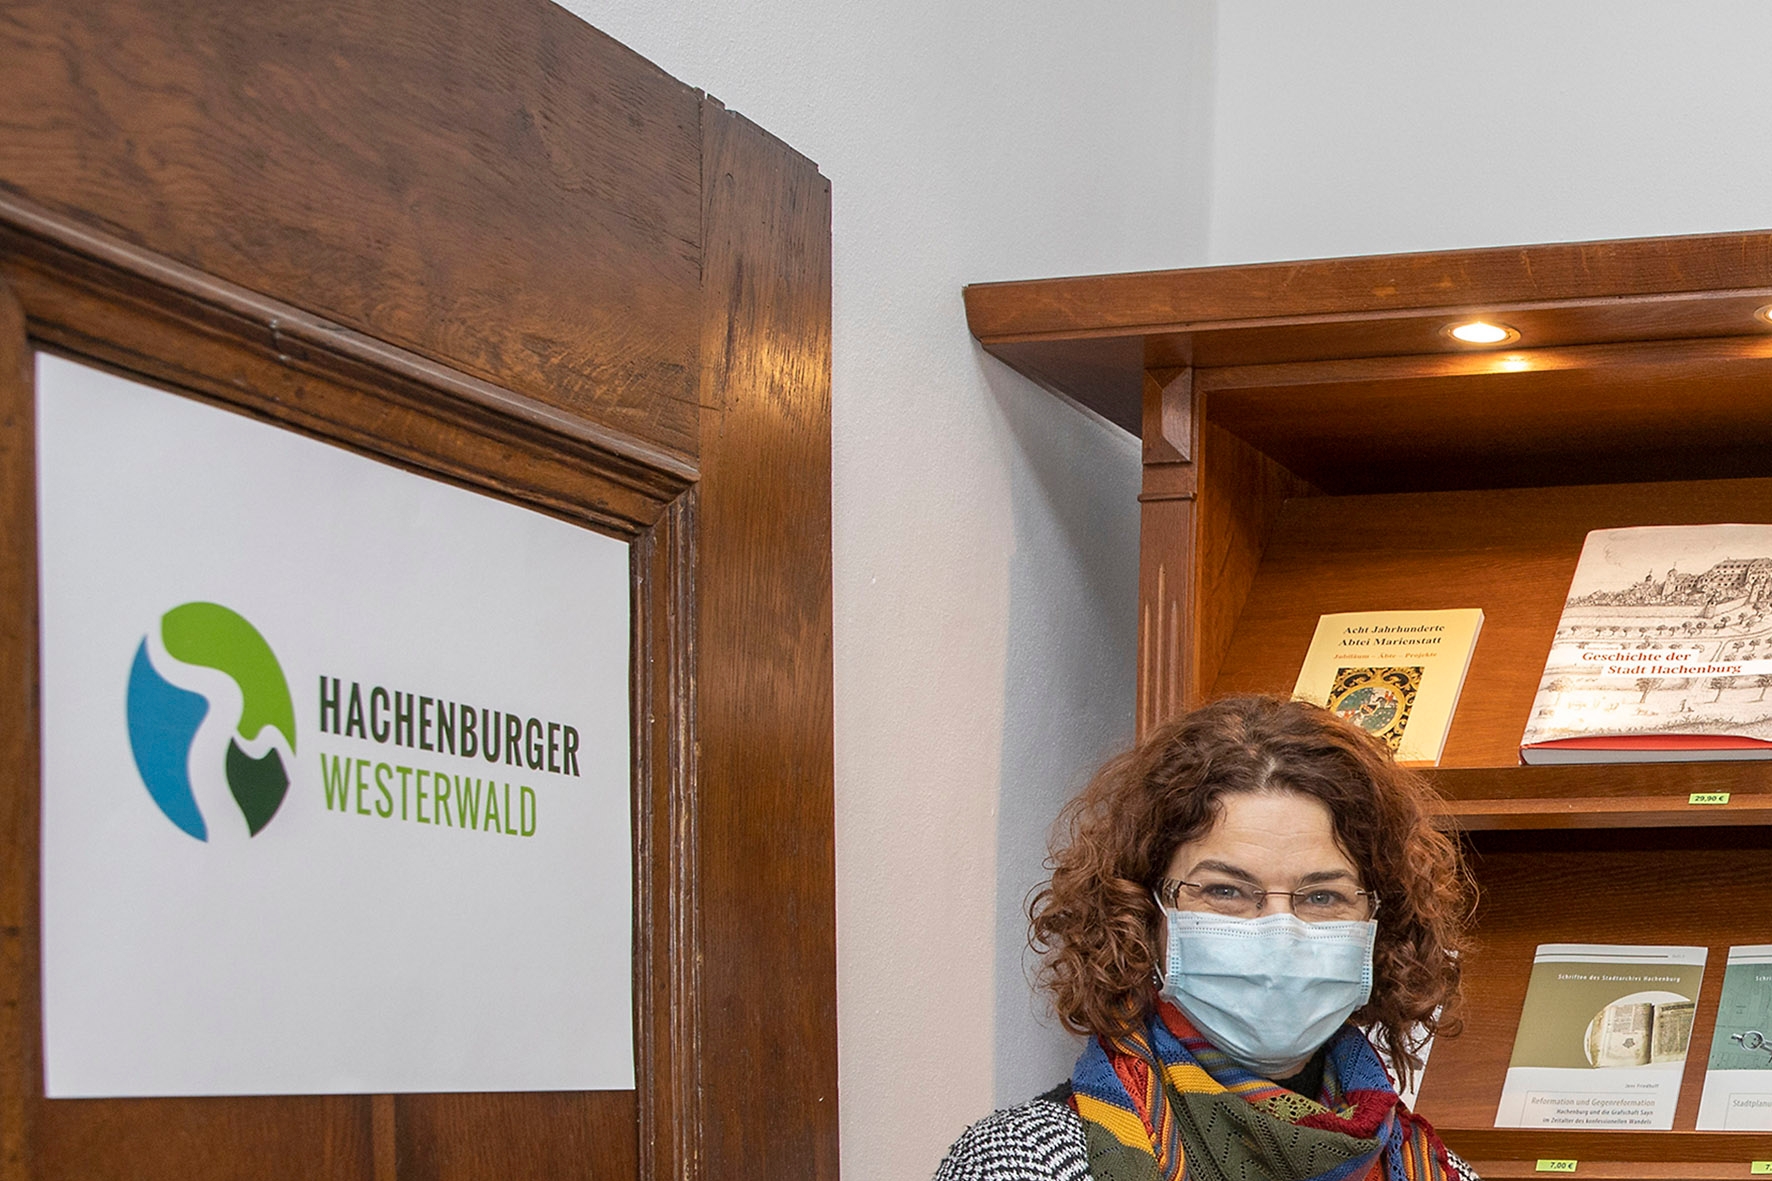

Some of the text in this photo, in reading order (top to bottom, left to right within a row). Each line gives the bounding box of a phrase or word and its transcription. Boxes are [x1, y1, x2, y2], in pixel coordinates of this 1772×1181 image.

[1343, 624, 1445, 634] Acht Jahrhunderte
[1339, 637, 1442, 646] Abtei Marienstatt
[1582, 652, 1691, 662] Geschichte der
[1607, 664, 1743, 675] Stadt Hachenburg
[319, 674, 581, 778] HACHENBURGER
[319, 752, 537, 838] WESTERWALD
[1558, 973, 1588, 981] Schriften
[1602, 974, 1642, 982] Stadtarchivs
[1643, 975, 1681, 983] Hachenburg
[1530, 1096, 1656, 1108] Reformation und Gegenreformation
[1550, 1162, 1574, 1170] 7,00 €
